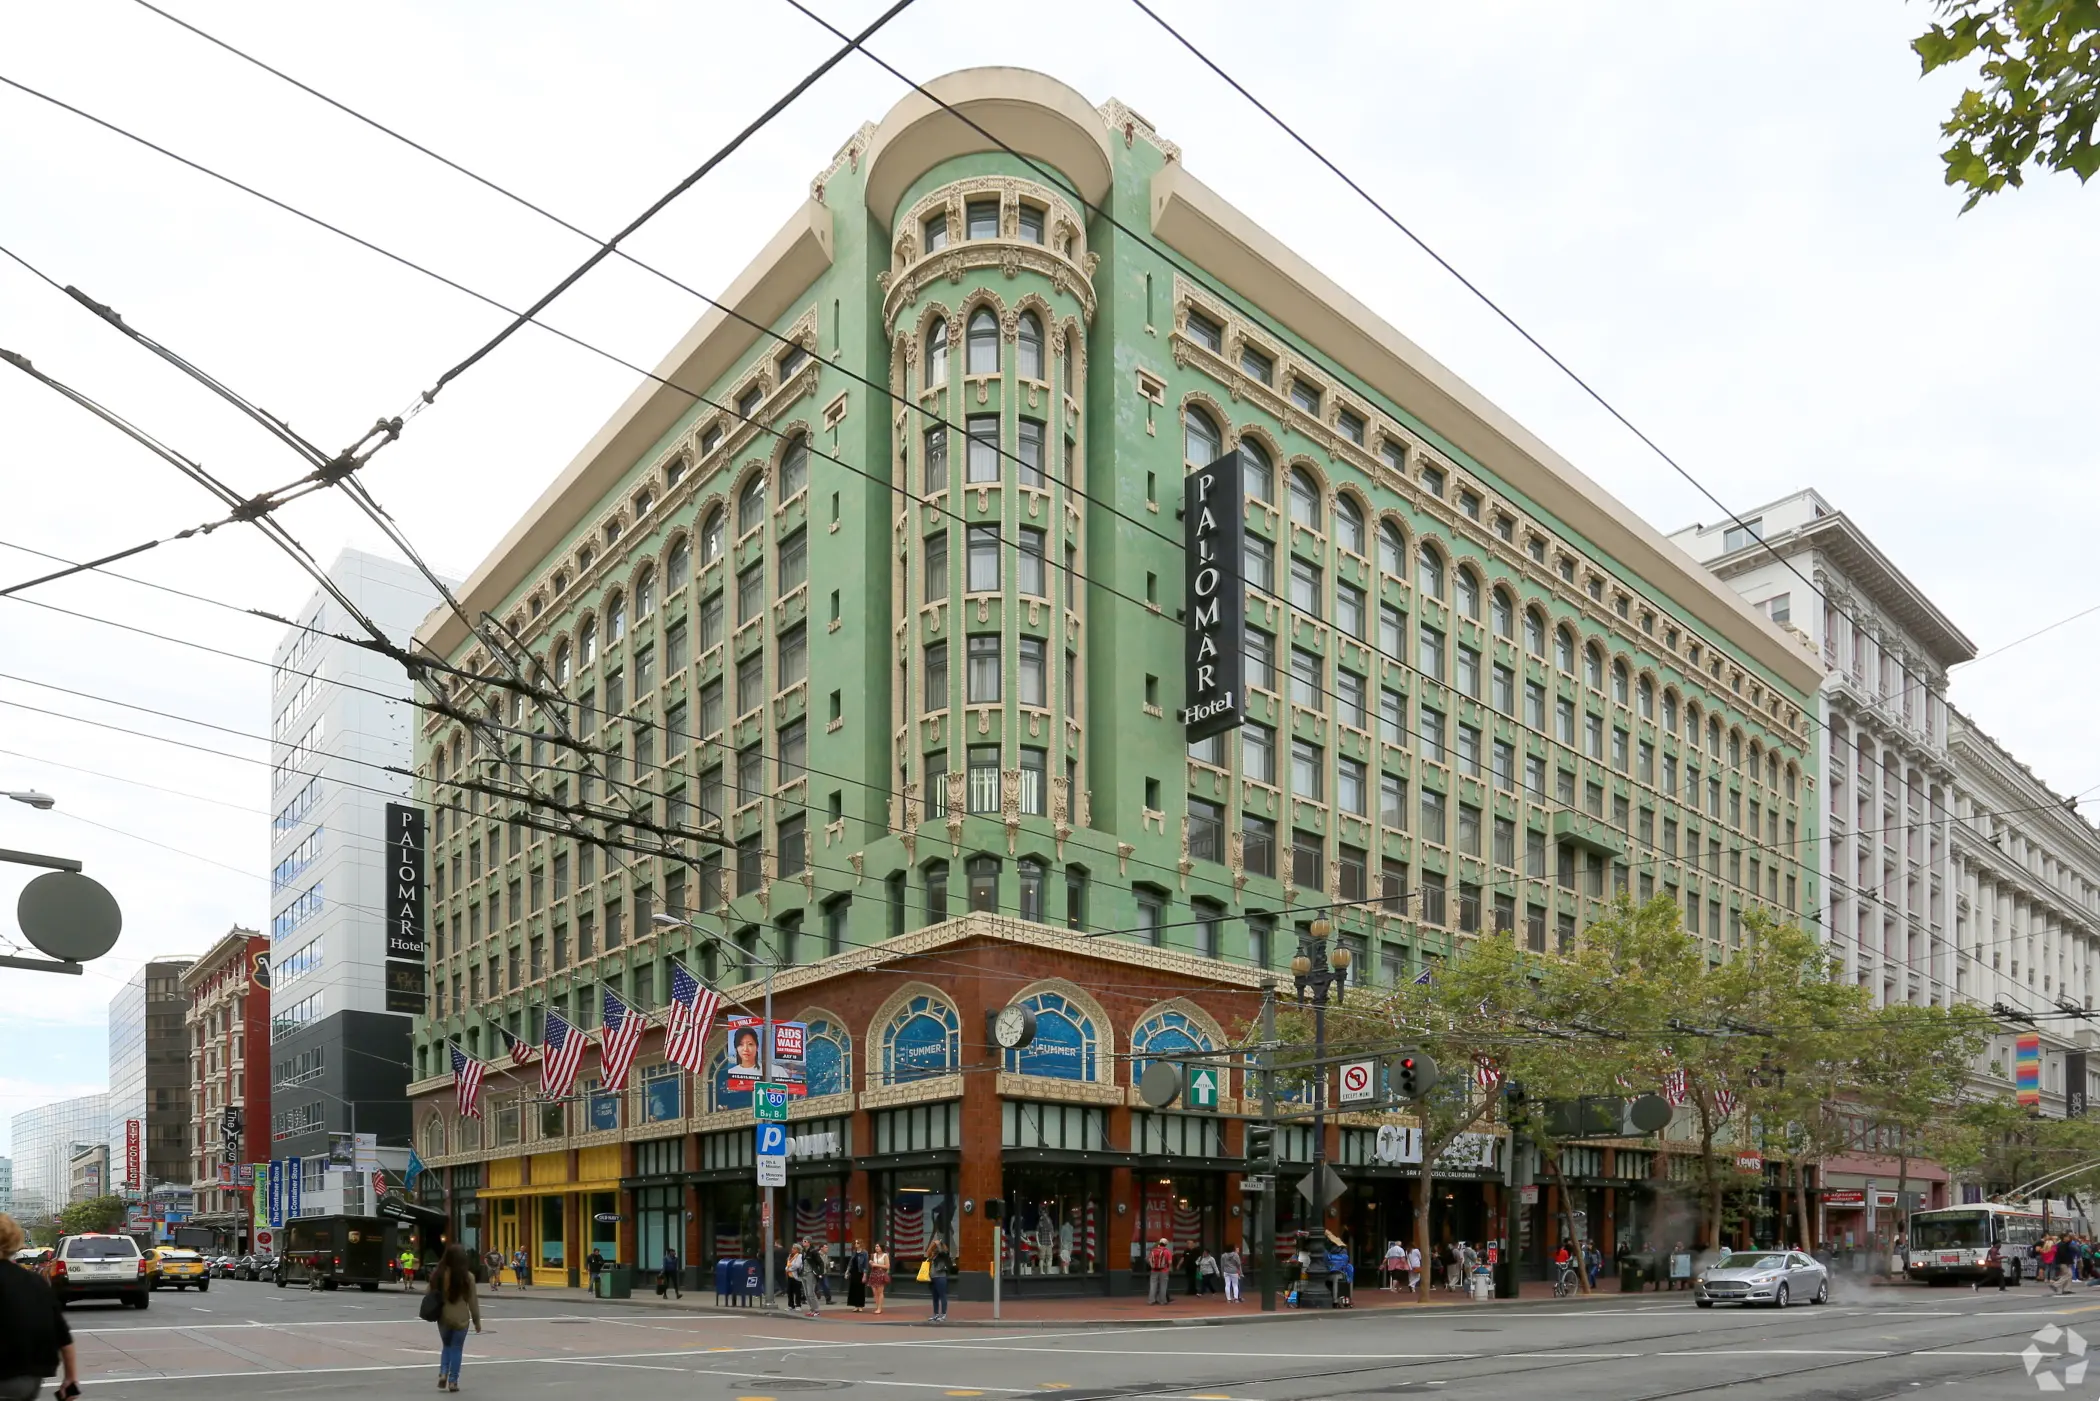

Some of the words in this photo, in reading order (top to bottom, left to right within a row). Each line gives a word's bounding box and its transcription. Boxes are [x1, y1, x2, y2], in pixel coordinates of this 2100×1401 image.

[1194, 474, 1220, 693] PALOMAR
[1184, 691, 1235, 726] Hotel
[398, 812, 416, 936] PALOMAR
[390, 938, 425, 952] Hotel
[778, 1028, 801, 1038] AIDS
[777, 1039, 801, 1048] WALK
[1038, 1044, 1076, 1056] SUMMER
[909, 1044, 941, 1057] SUMMER
[770, 1094, 782, 1103] 80
[228, 1111, 237, 1128] The
